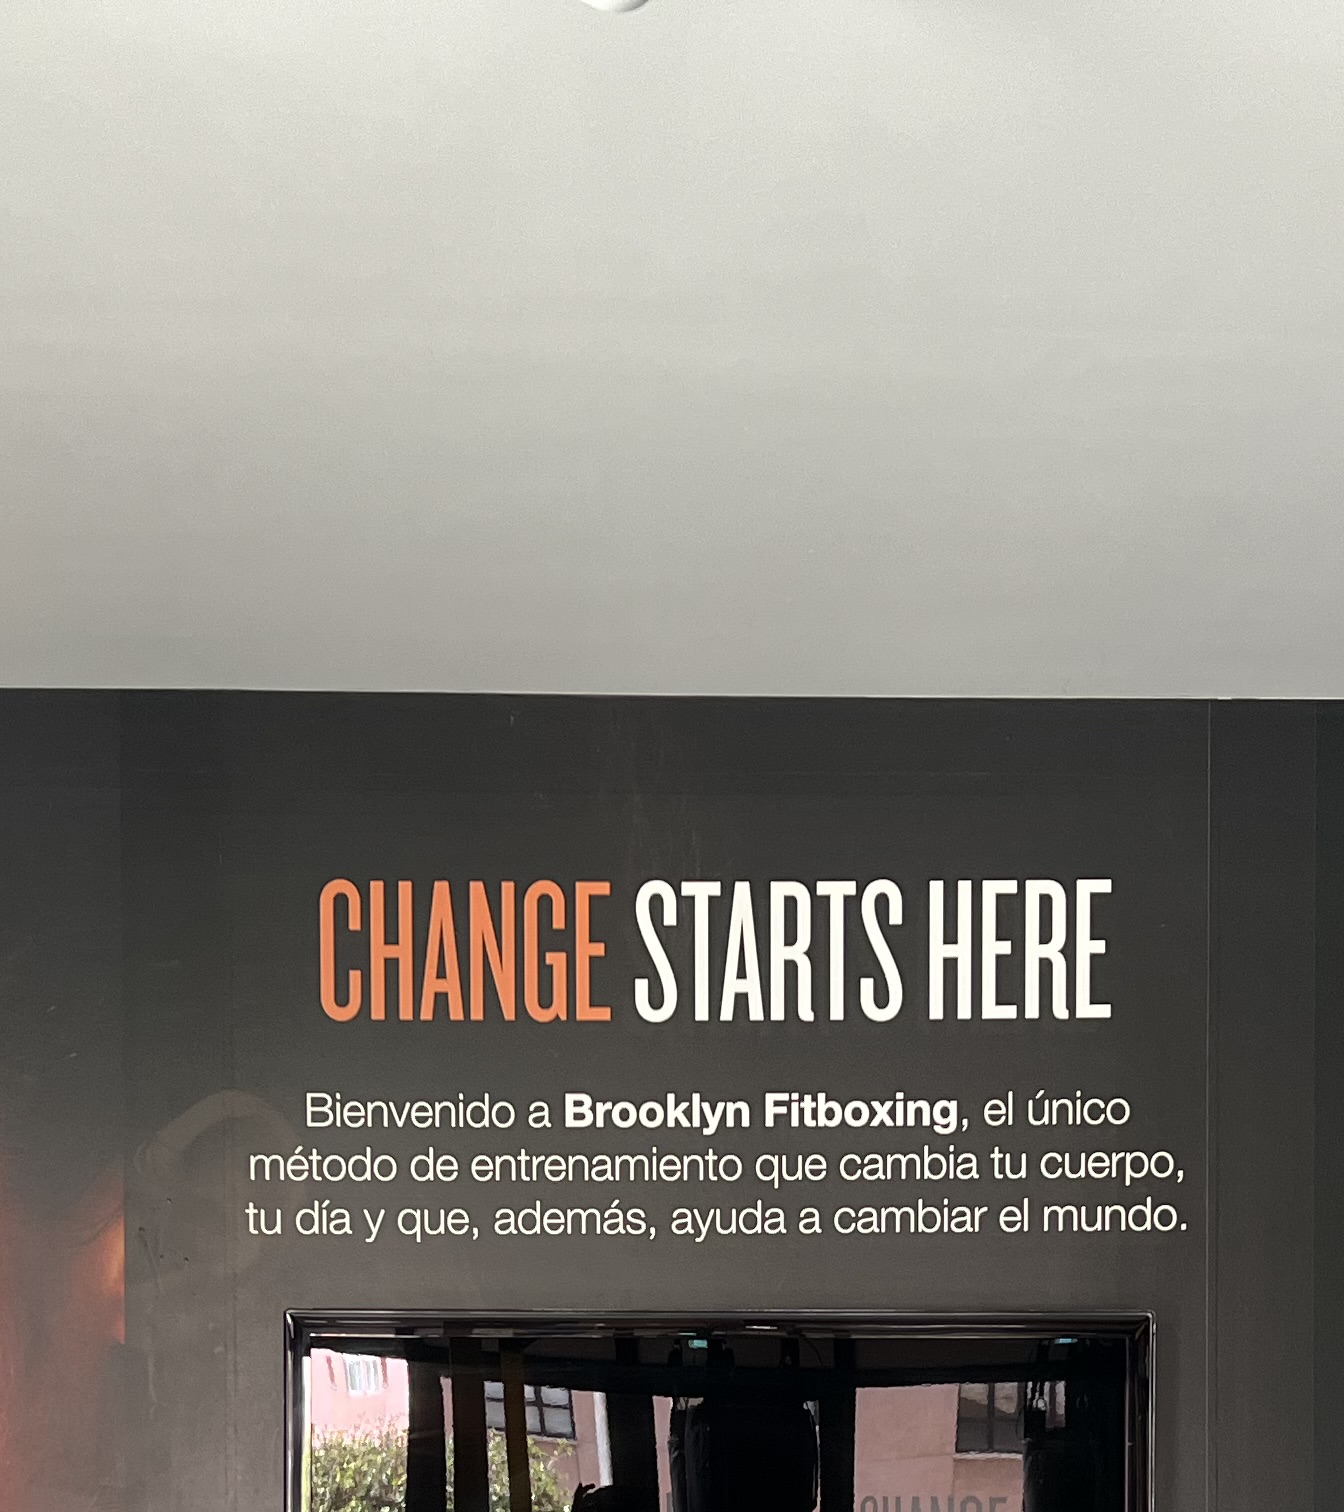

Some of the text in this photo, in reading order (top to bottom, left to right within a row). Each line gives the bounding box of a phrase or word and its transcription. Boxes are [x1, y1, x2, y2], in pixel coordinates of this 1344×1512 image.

[319, 878, 1112, 1023] CHANGE STARTS HERE
[306, 1089, 1131, 1136] Bienvenido a Brooklyn Fitboxing, el único
[249, 1144, 1184, 1190] método de entrenamiento que cambia tu cuerpo,
[244, 1196, 1187, 1243] tu día y que, además, ayuda a cambiar el mundo.
